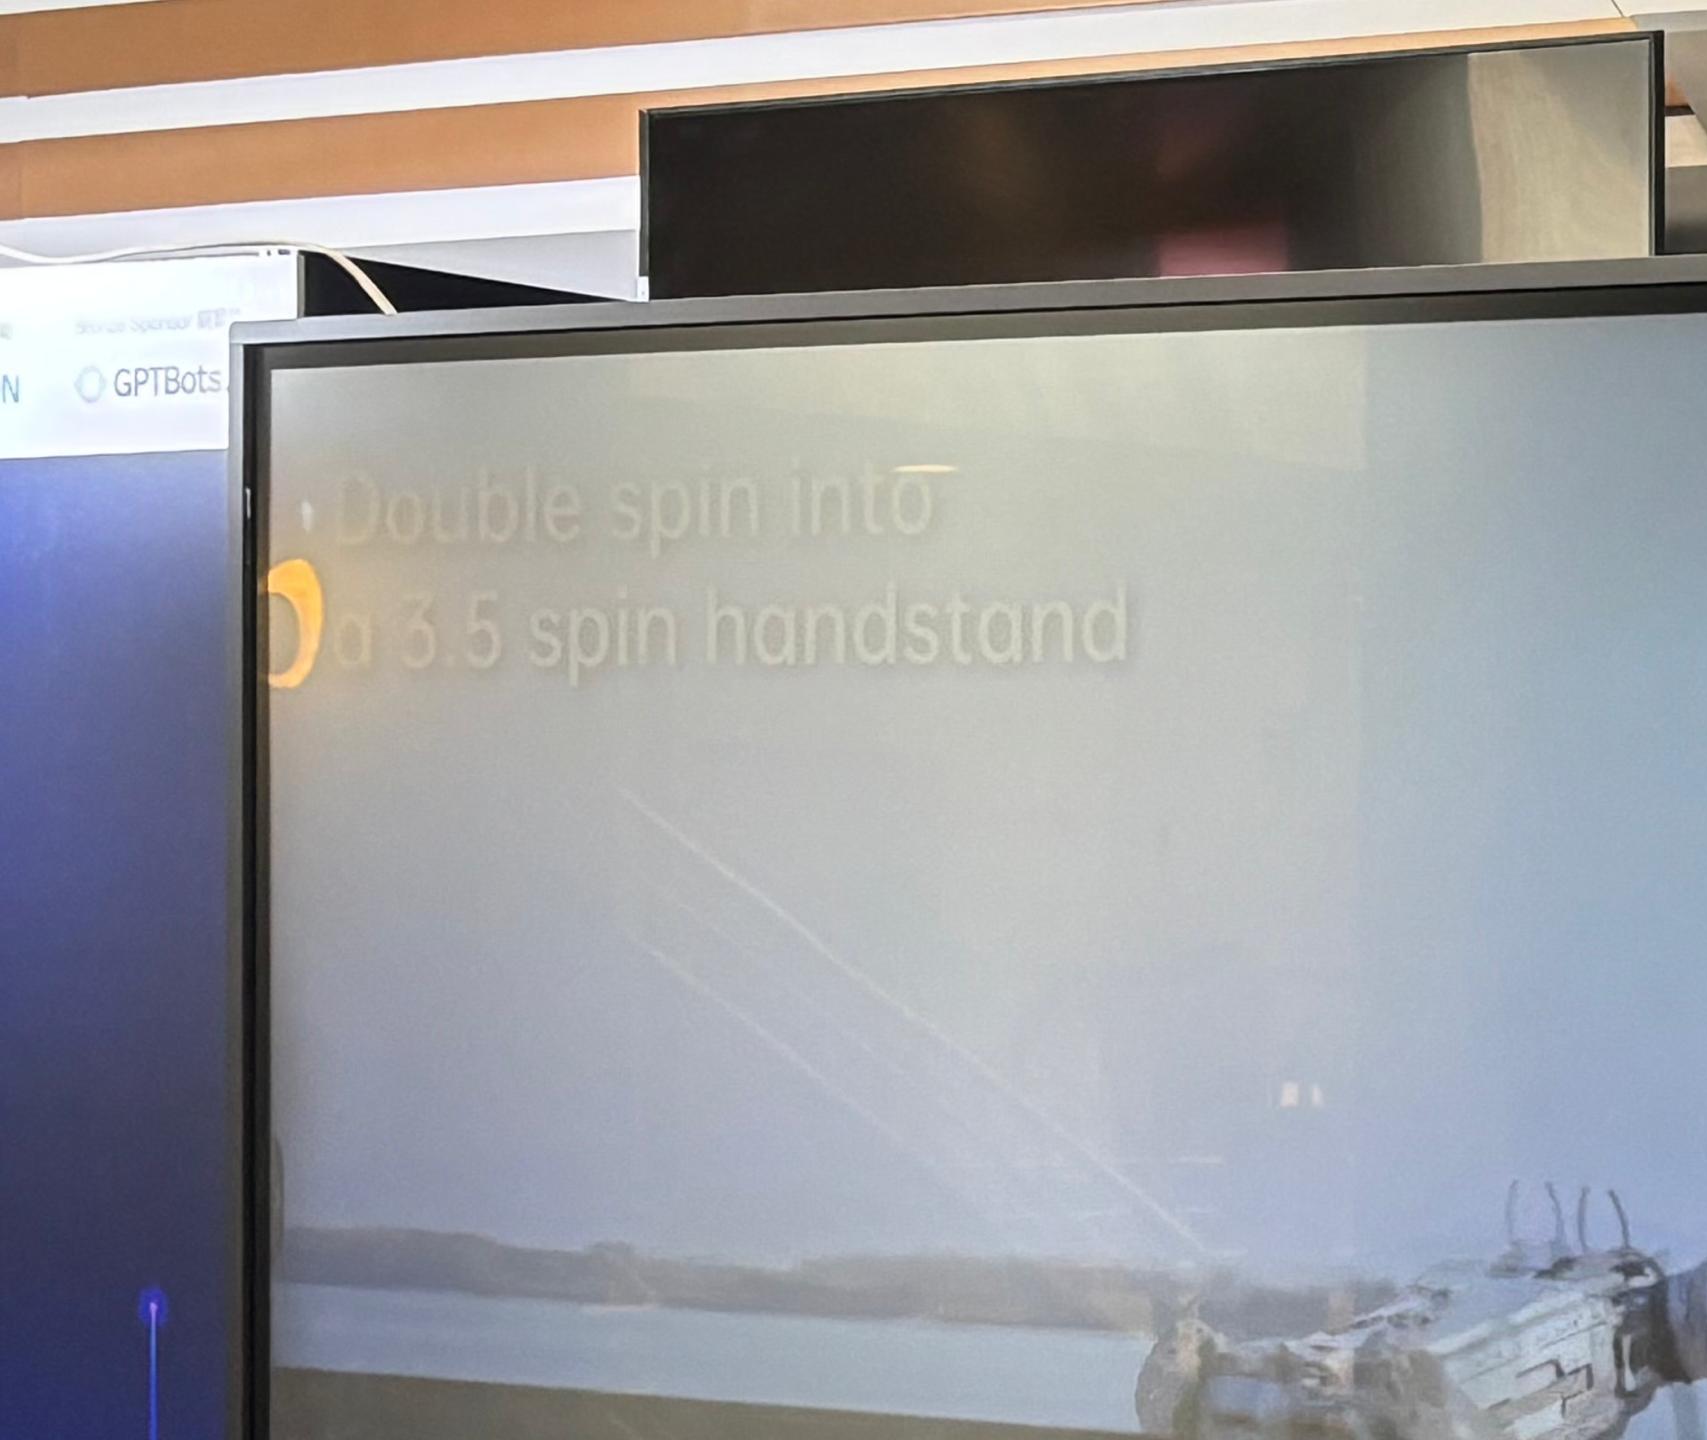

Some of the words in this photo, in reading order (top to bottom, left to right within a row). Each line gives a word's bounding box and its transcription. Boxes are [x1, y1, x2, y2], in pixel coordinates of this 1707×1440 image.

[336, 464, 582, 544] Double
[609, 466, 761, 559] spin
[789, 455, 932, 535] into
[334, 611, 372, 667] a
[400, 589, 501, 669] 3.5
[529, 583, 678, 688] spin
[705, 579, 1128, 666] handstand
